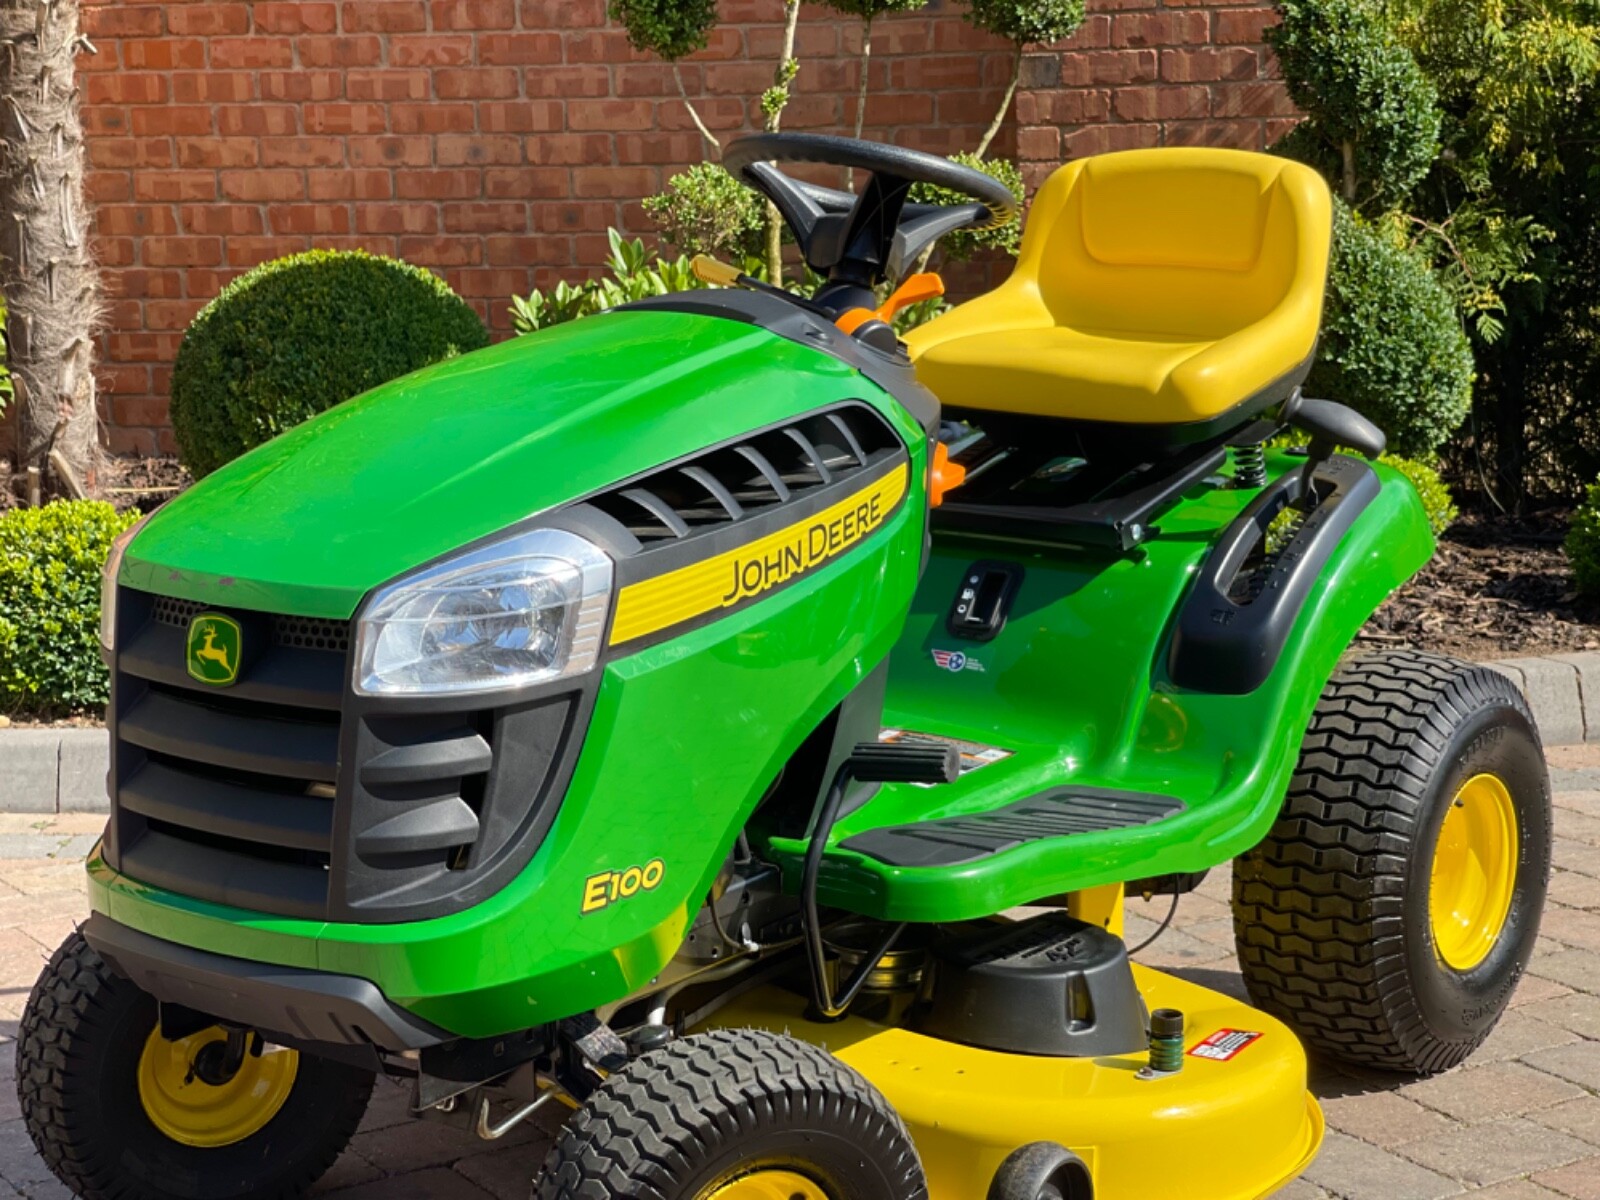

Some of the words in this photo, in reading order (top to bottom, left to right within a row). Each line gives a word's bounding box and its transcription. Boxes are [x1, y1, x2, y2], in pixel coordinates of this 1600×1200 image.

[723, 539, 802, 602] JOHN
[809, 492, 881, 562] DEERE
[581, 858, 664, 914] E100
